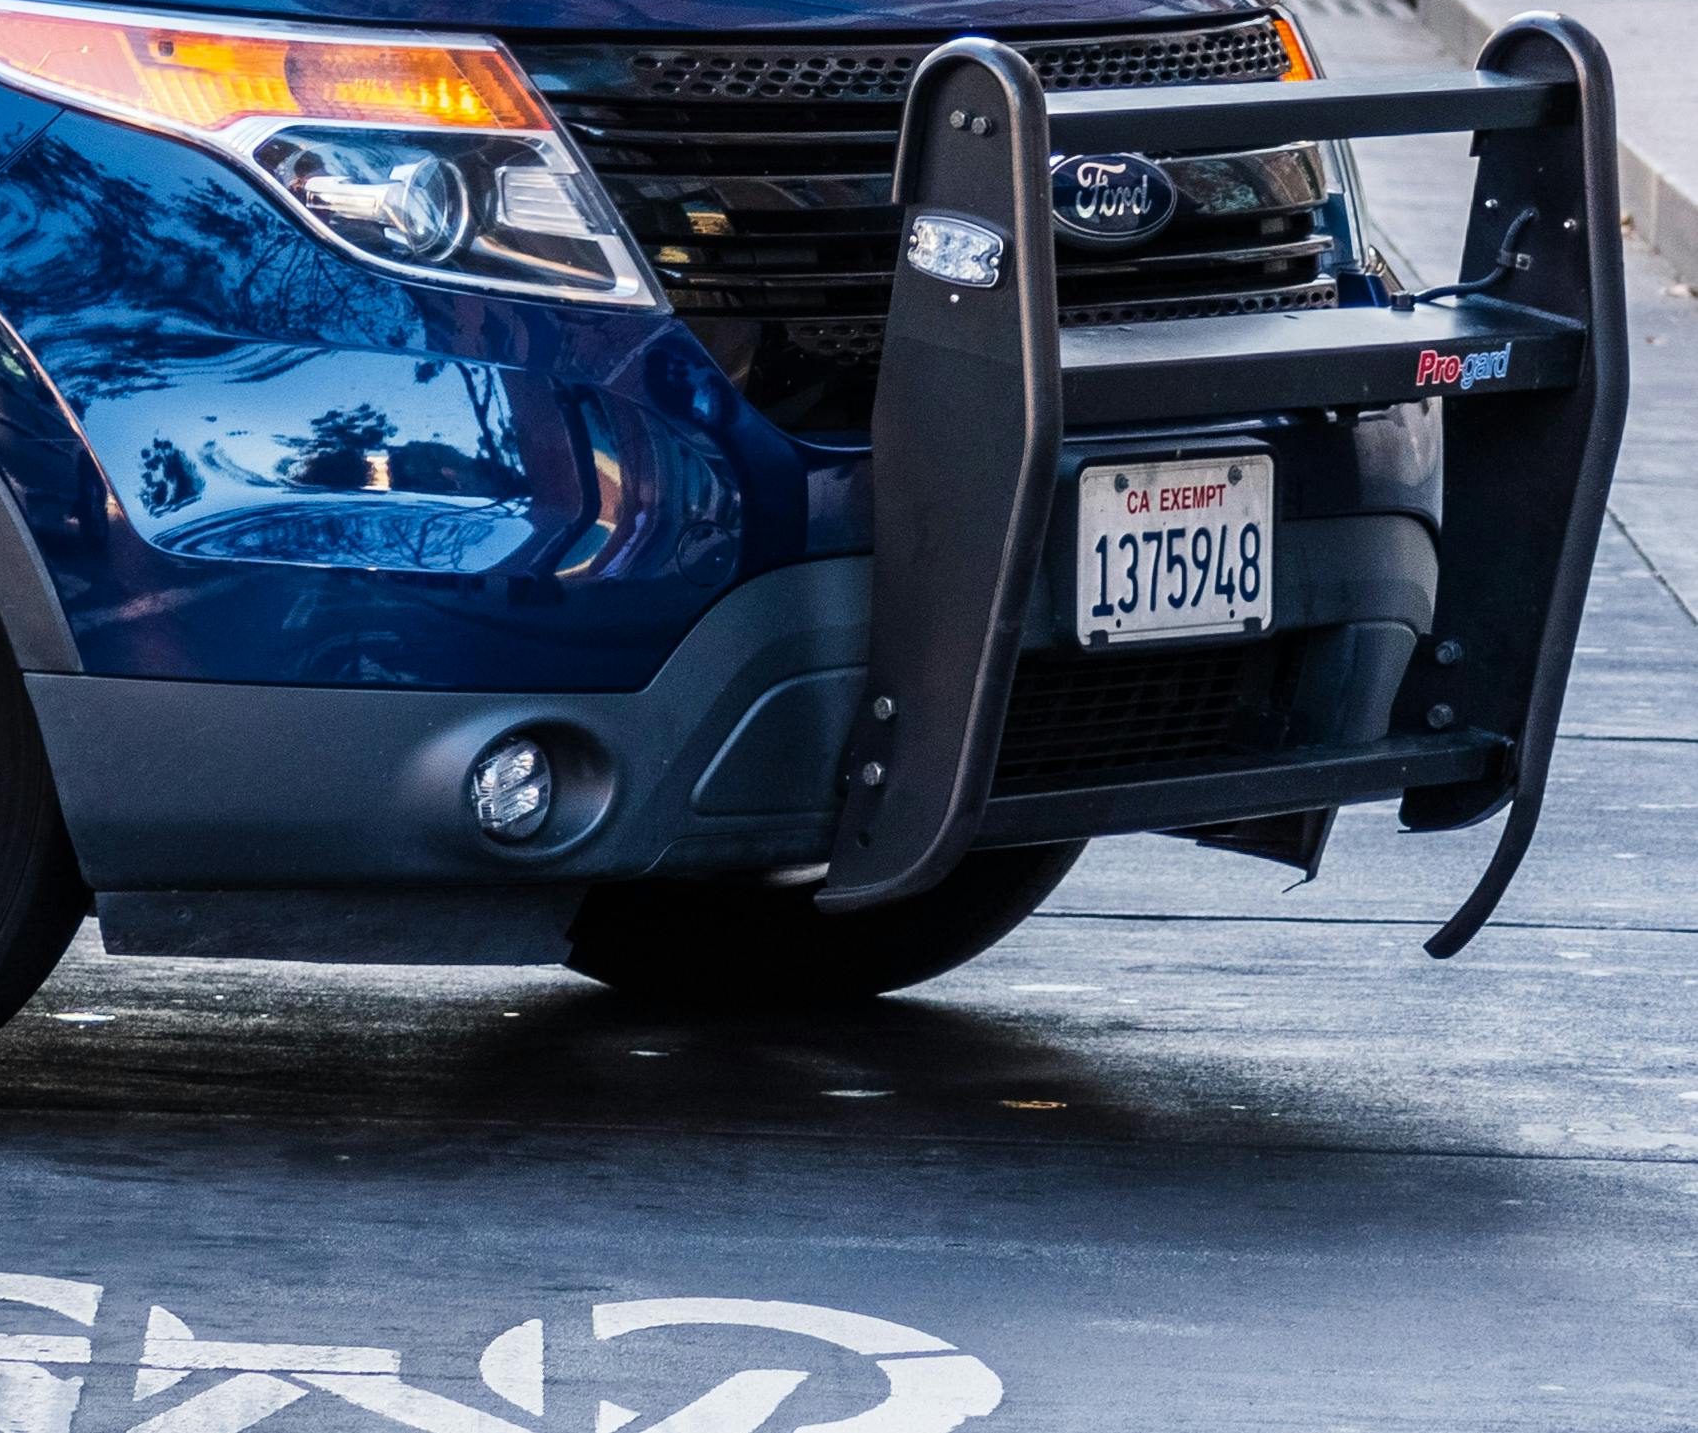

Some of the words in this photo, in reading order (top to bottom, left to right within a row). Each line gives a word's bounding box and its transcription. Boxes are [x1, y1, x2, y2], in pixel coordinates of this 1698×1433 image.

[1076, 162, 1152, 219] Ford
[1127, 490, 1150, 514] CA
[1159, 484, 1227, 512] EXEMPT
[1092, 522, 1261, 617] 1375948
